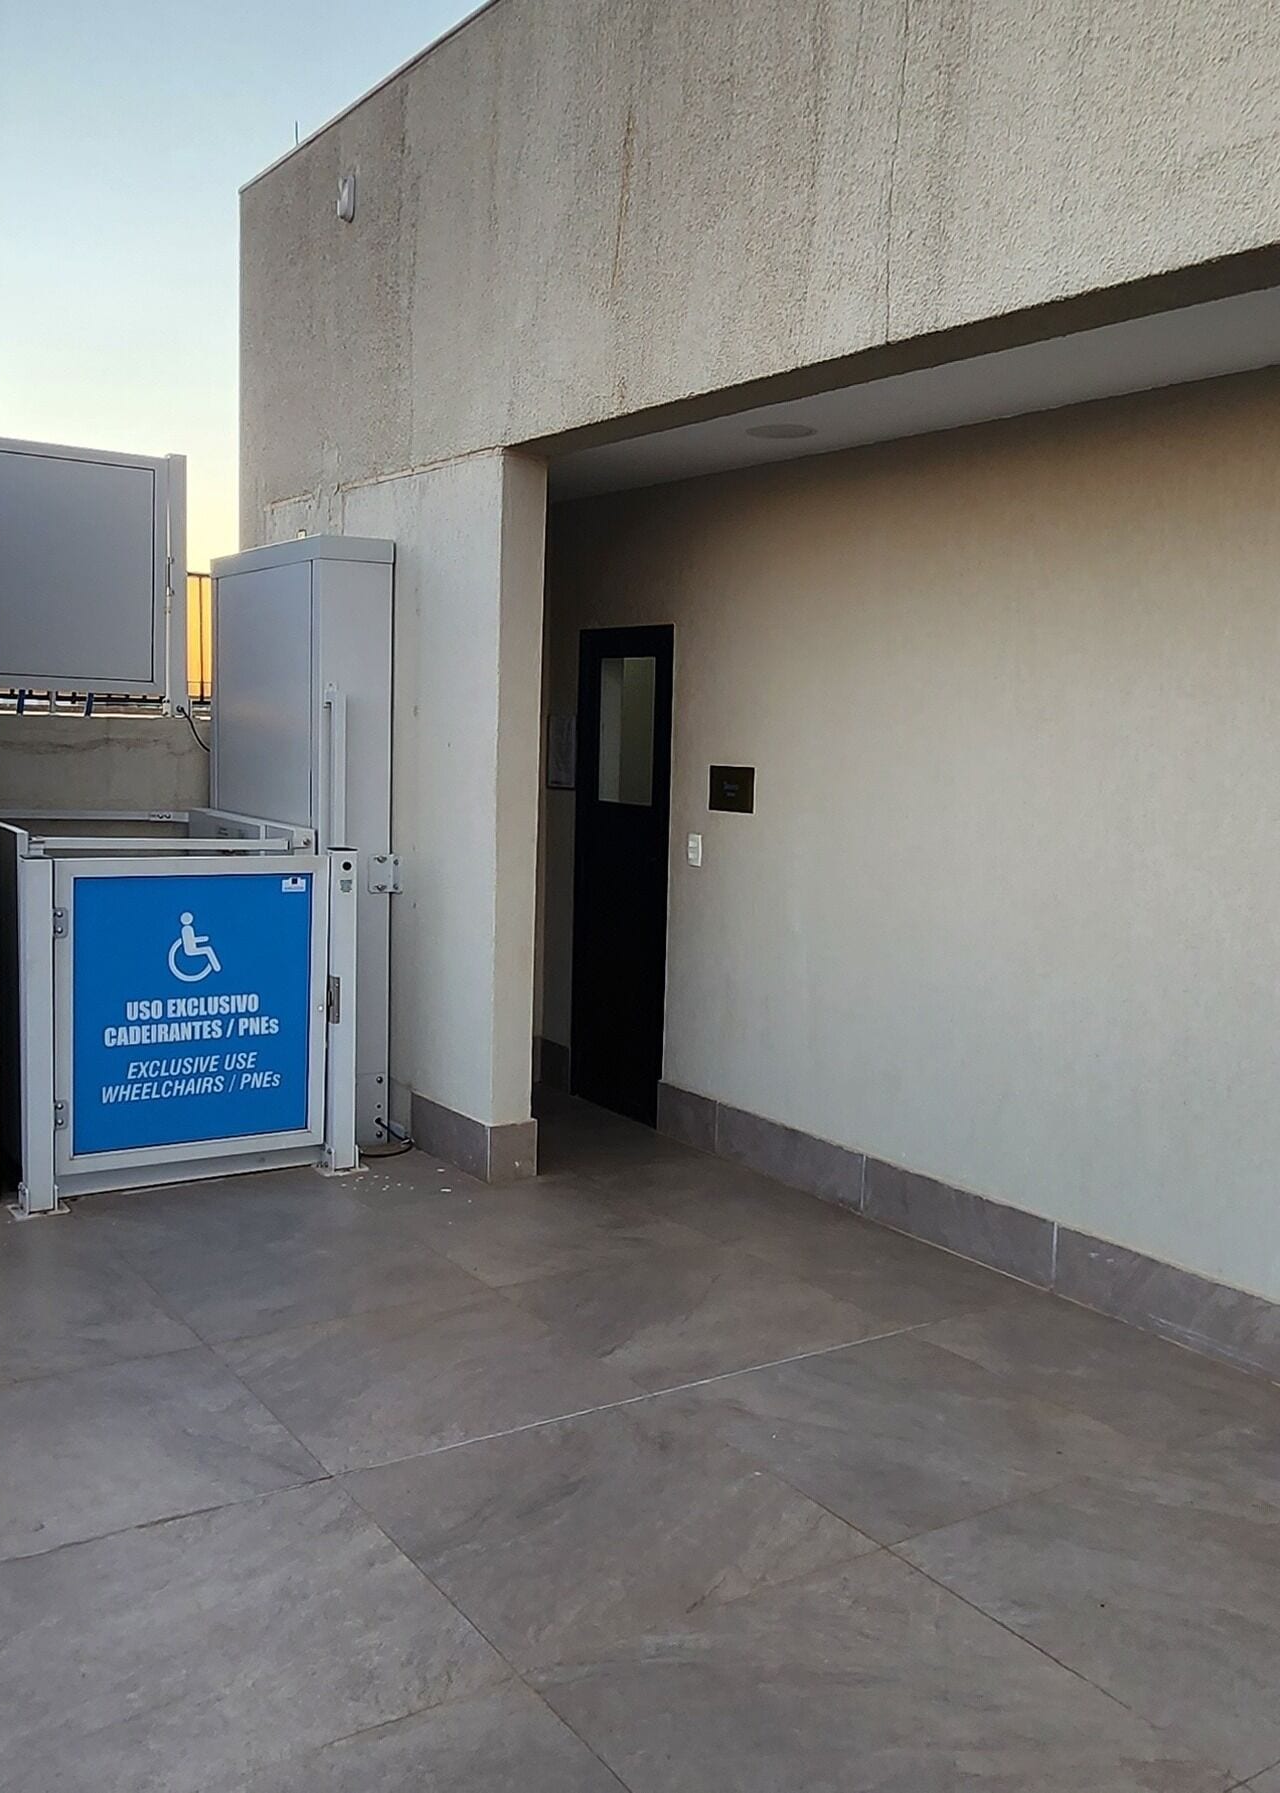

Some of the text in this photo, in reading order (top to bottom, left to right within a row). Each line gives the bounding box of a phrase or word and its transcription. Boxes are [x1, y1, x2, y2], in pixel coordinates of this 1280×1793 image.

[126, 993, 260, 1021] USO EXCLUSIVO
[104, 1016, 279, 1047] CADEIRANTES / PNEs
[127, 1051, 258, 1080] EXCLUSIVE USE
[102, 1071, 281, 1104] WHEELCHAIRS / PNEs
